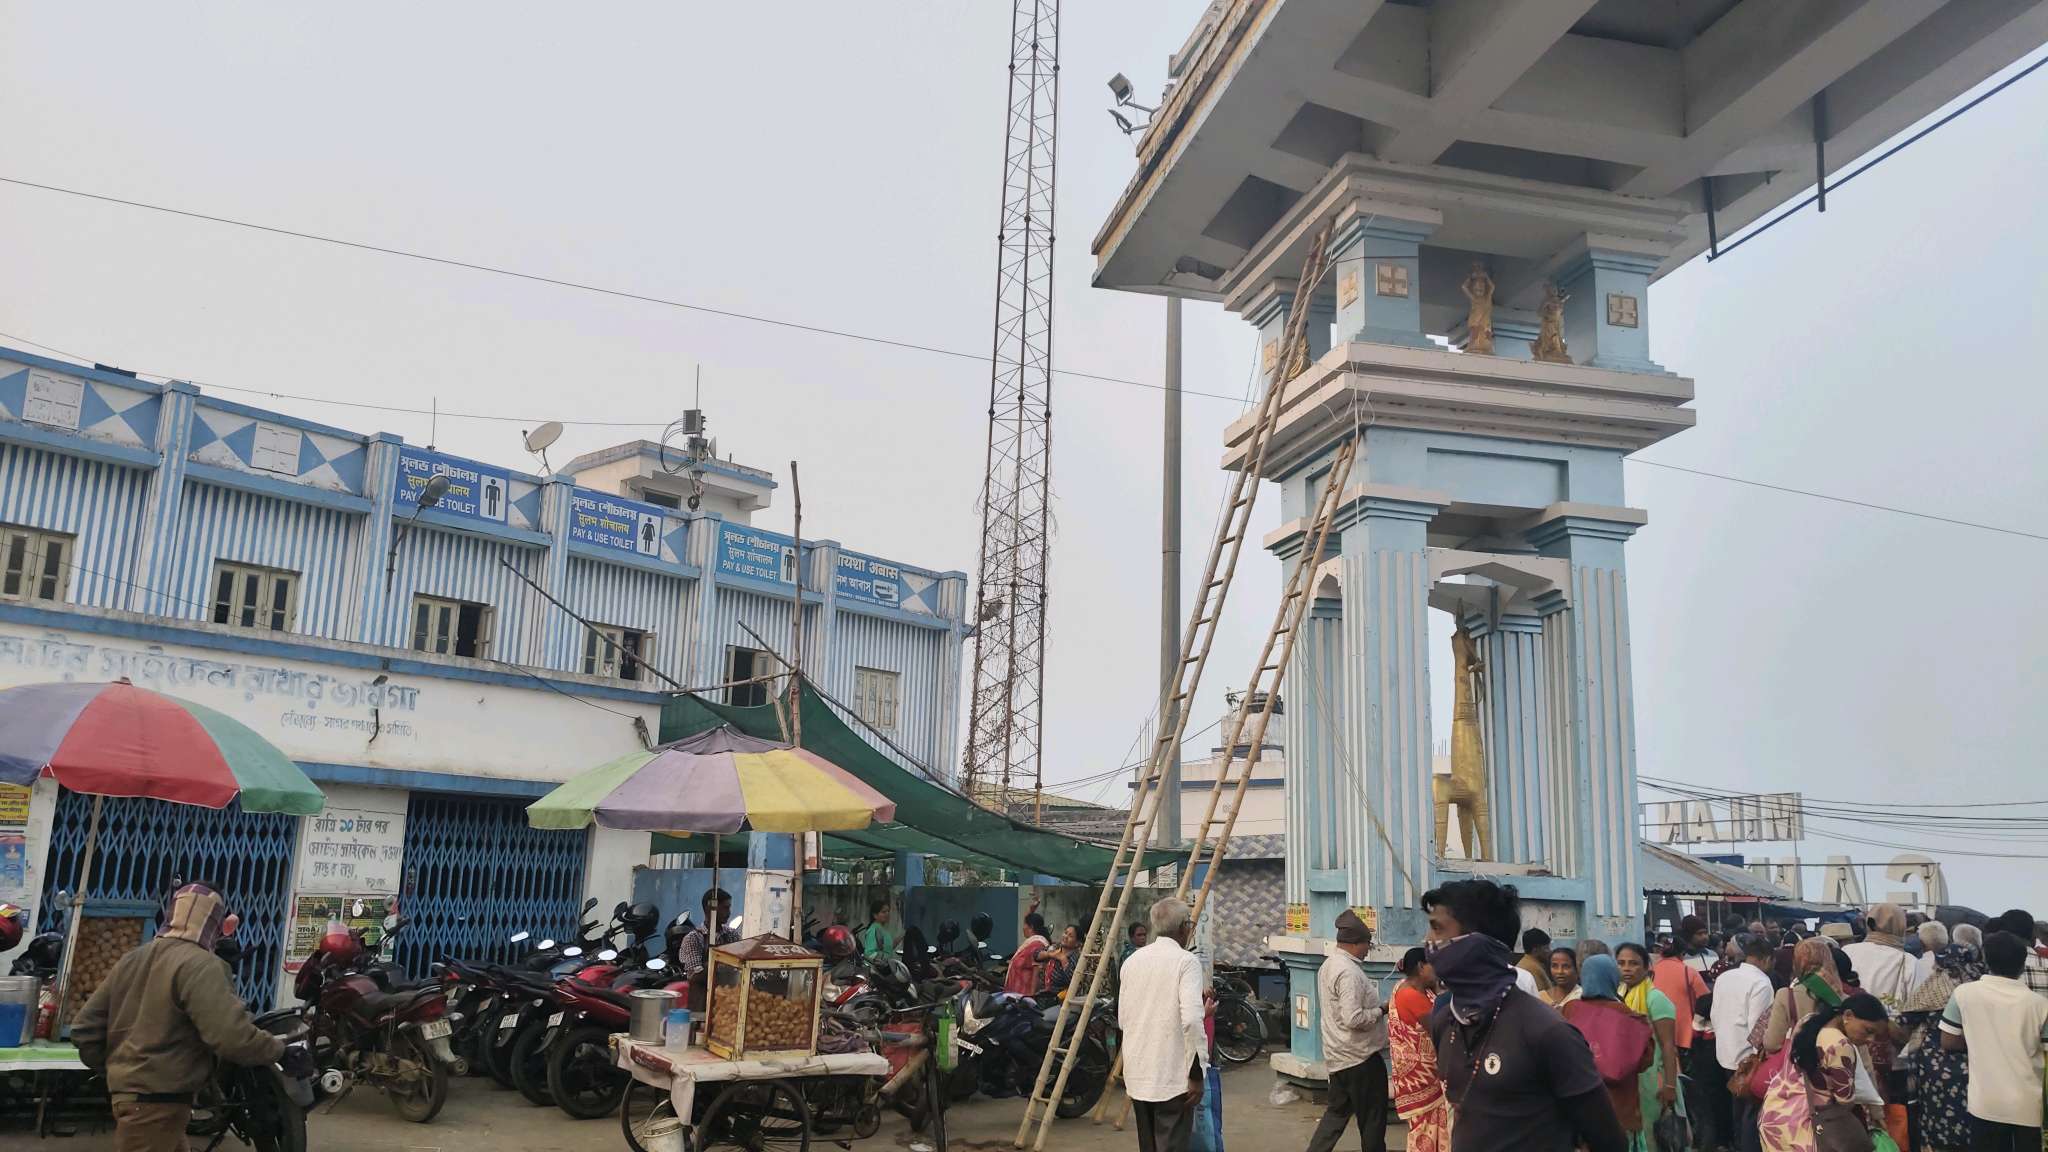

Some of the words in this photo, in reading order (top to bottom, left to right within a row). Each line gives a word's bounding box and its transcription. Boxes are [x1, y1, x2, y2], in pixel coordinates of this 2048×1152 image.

[400, 489, 417, 502] PAY
[446, 498, 476, 515] TOILET
[572, 527, 586, 538] PAY
[587, 530, 593, 540] &
[594, 532, 609, 544] USE
[609, 536, 635, 551] TOILET
[722, 560, 735, 570] PAY
[735, 563, 741, 573] &
[741, 564, 754, 576] USE
[754, 567, 777, 582] TOILET
